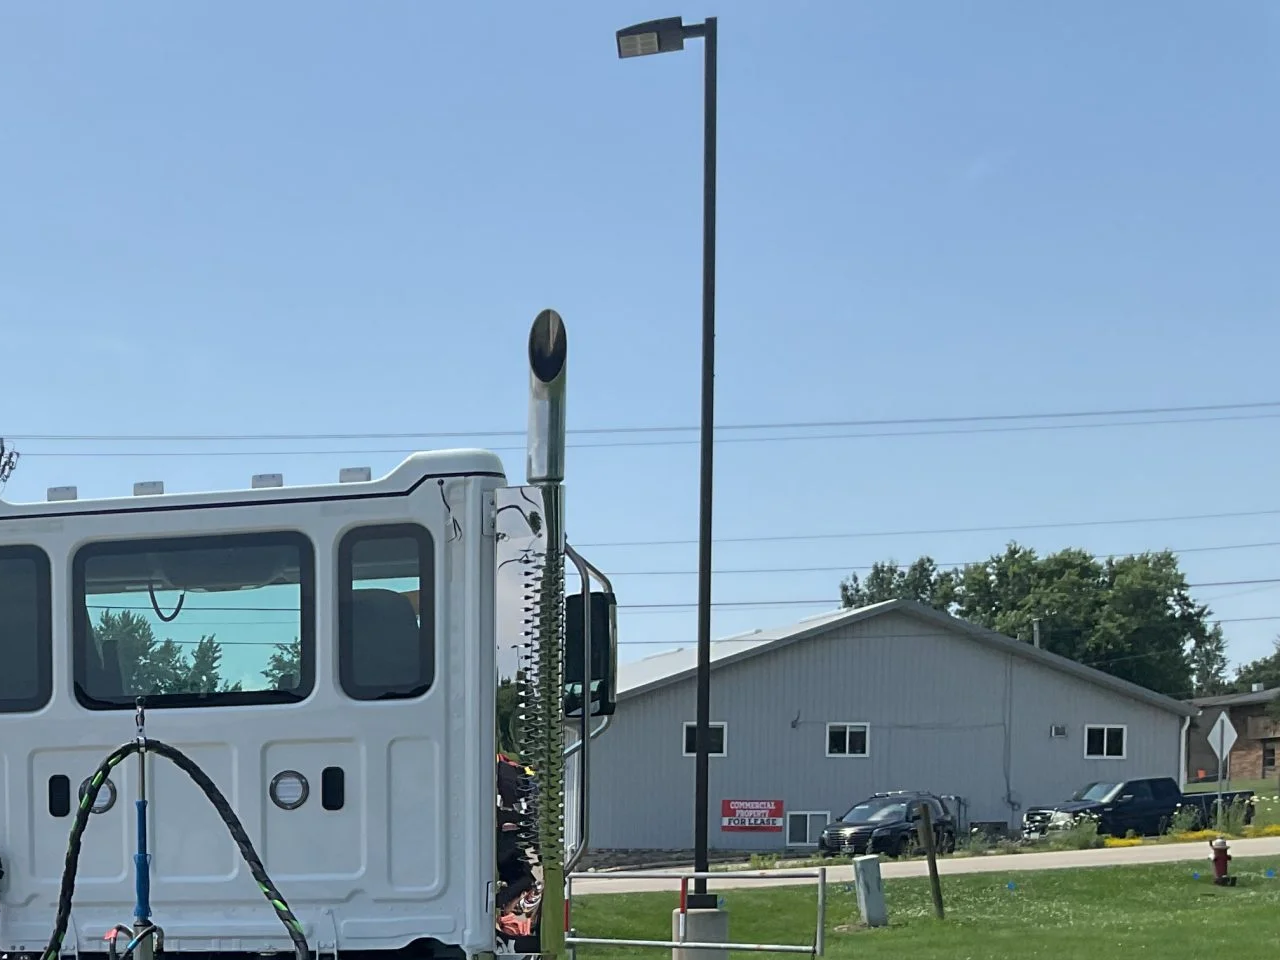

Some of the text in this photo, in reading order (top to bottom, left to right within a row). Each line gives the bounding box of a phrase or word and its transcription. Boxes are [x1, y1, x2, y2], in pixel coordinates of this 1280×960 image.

[729, 801, 776, 809] COMMERCIAL
[735, 810, 770, 818] PROPERTY
[728, 818, 777, 826] FOR LEASE
